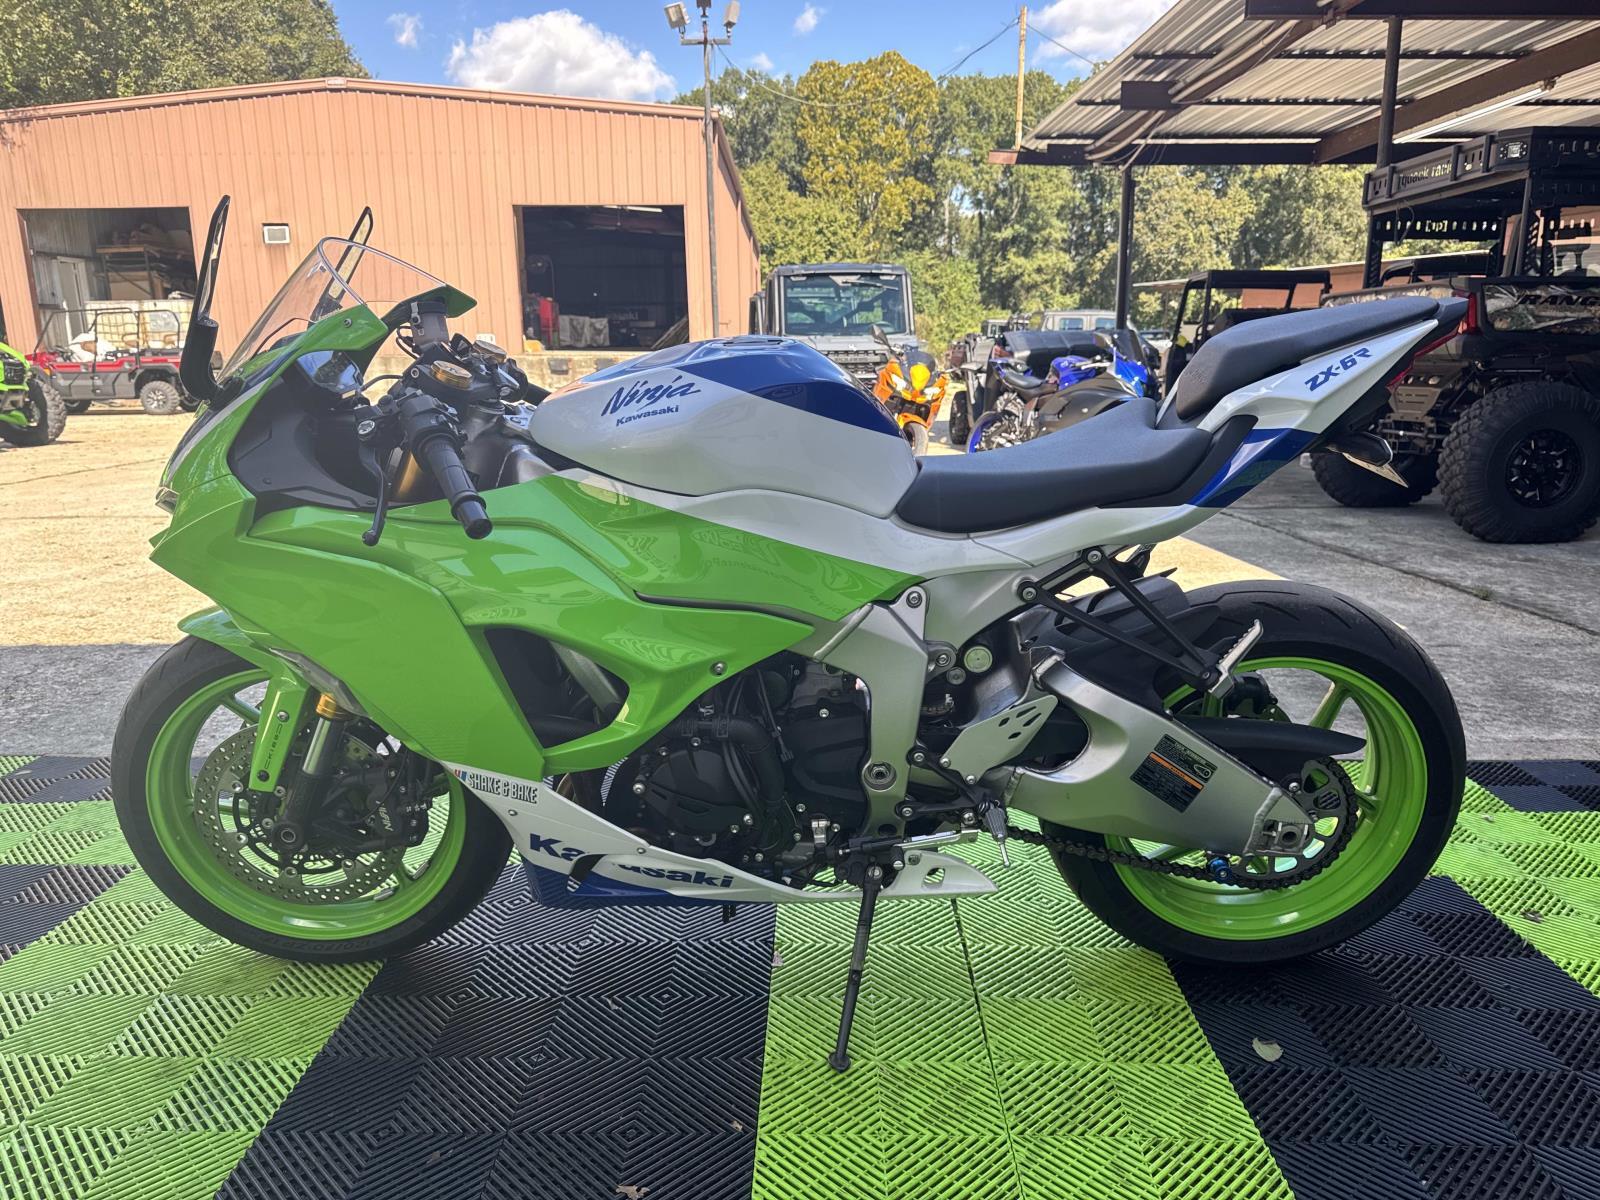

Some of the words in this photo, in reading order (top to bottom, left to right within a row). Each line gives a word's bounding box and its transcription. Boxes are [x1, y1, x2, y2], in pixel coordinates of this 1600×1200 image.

[1304, 347, 1373, 392] ZX-6R
[600, 375, 702, 417] Ninja
[616, 404, 680, 427] Kawasaki
[468, 772, 501, 796] SHAKE
[501, 780, 511, 797] &
[511, 781, 538, 805] BAKE
